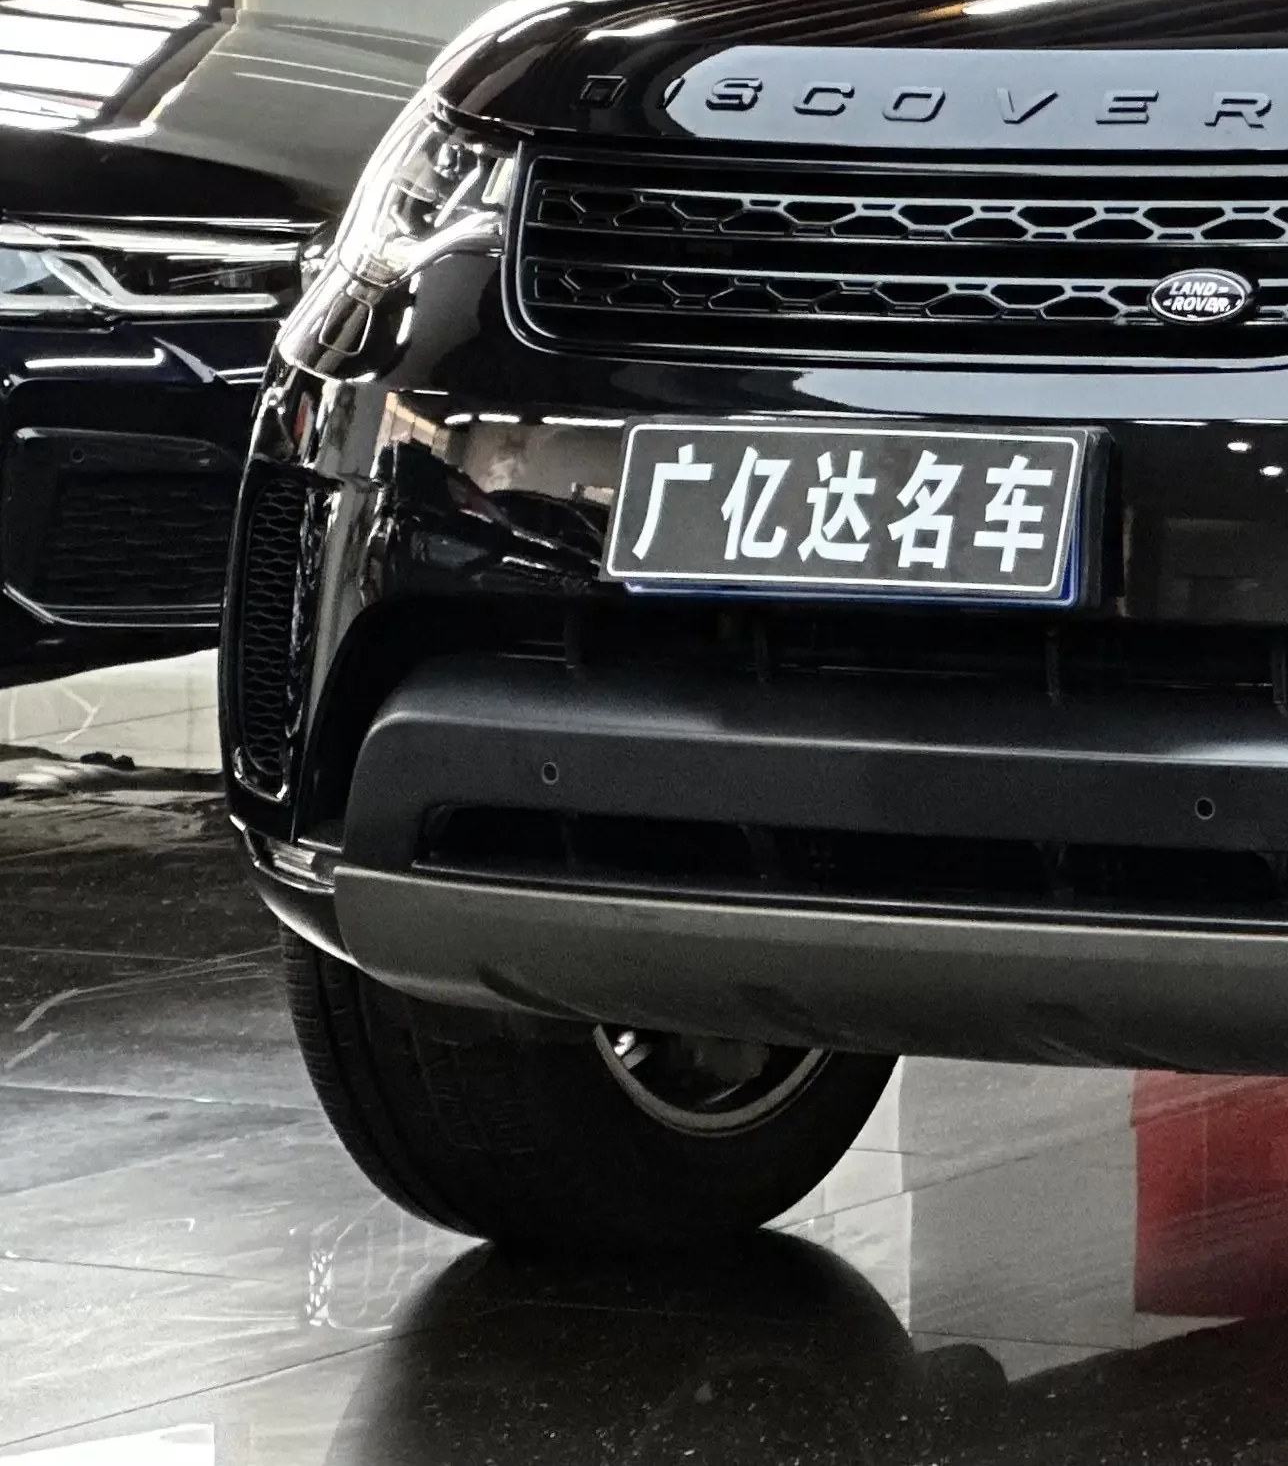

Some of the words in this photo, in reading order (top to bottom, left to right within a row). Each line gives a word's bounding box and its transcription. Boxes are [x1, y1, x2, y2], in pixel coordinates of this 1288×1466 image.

[1168, 281, 1218, 297] LAND
[631, 443, 1054, 573] 广亿达名车
